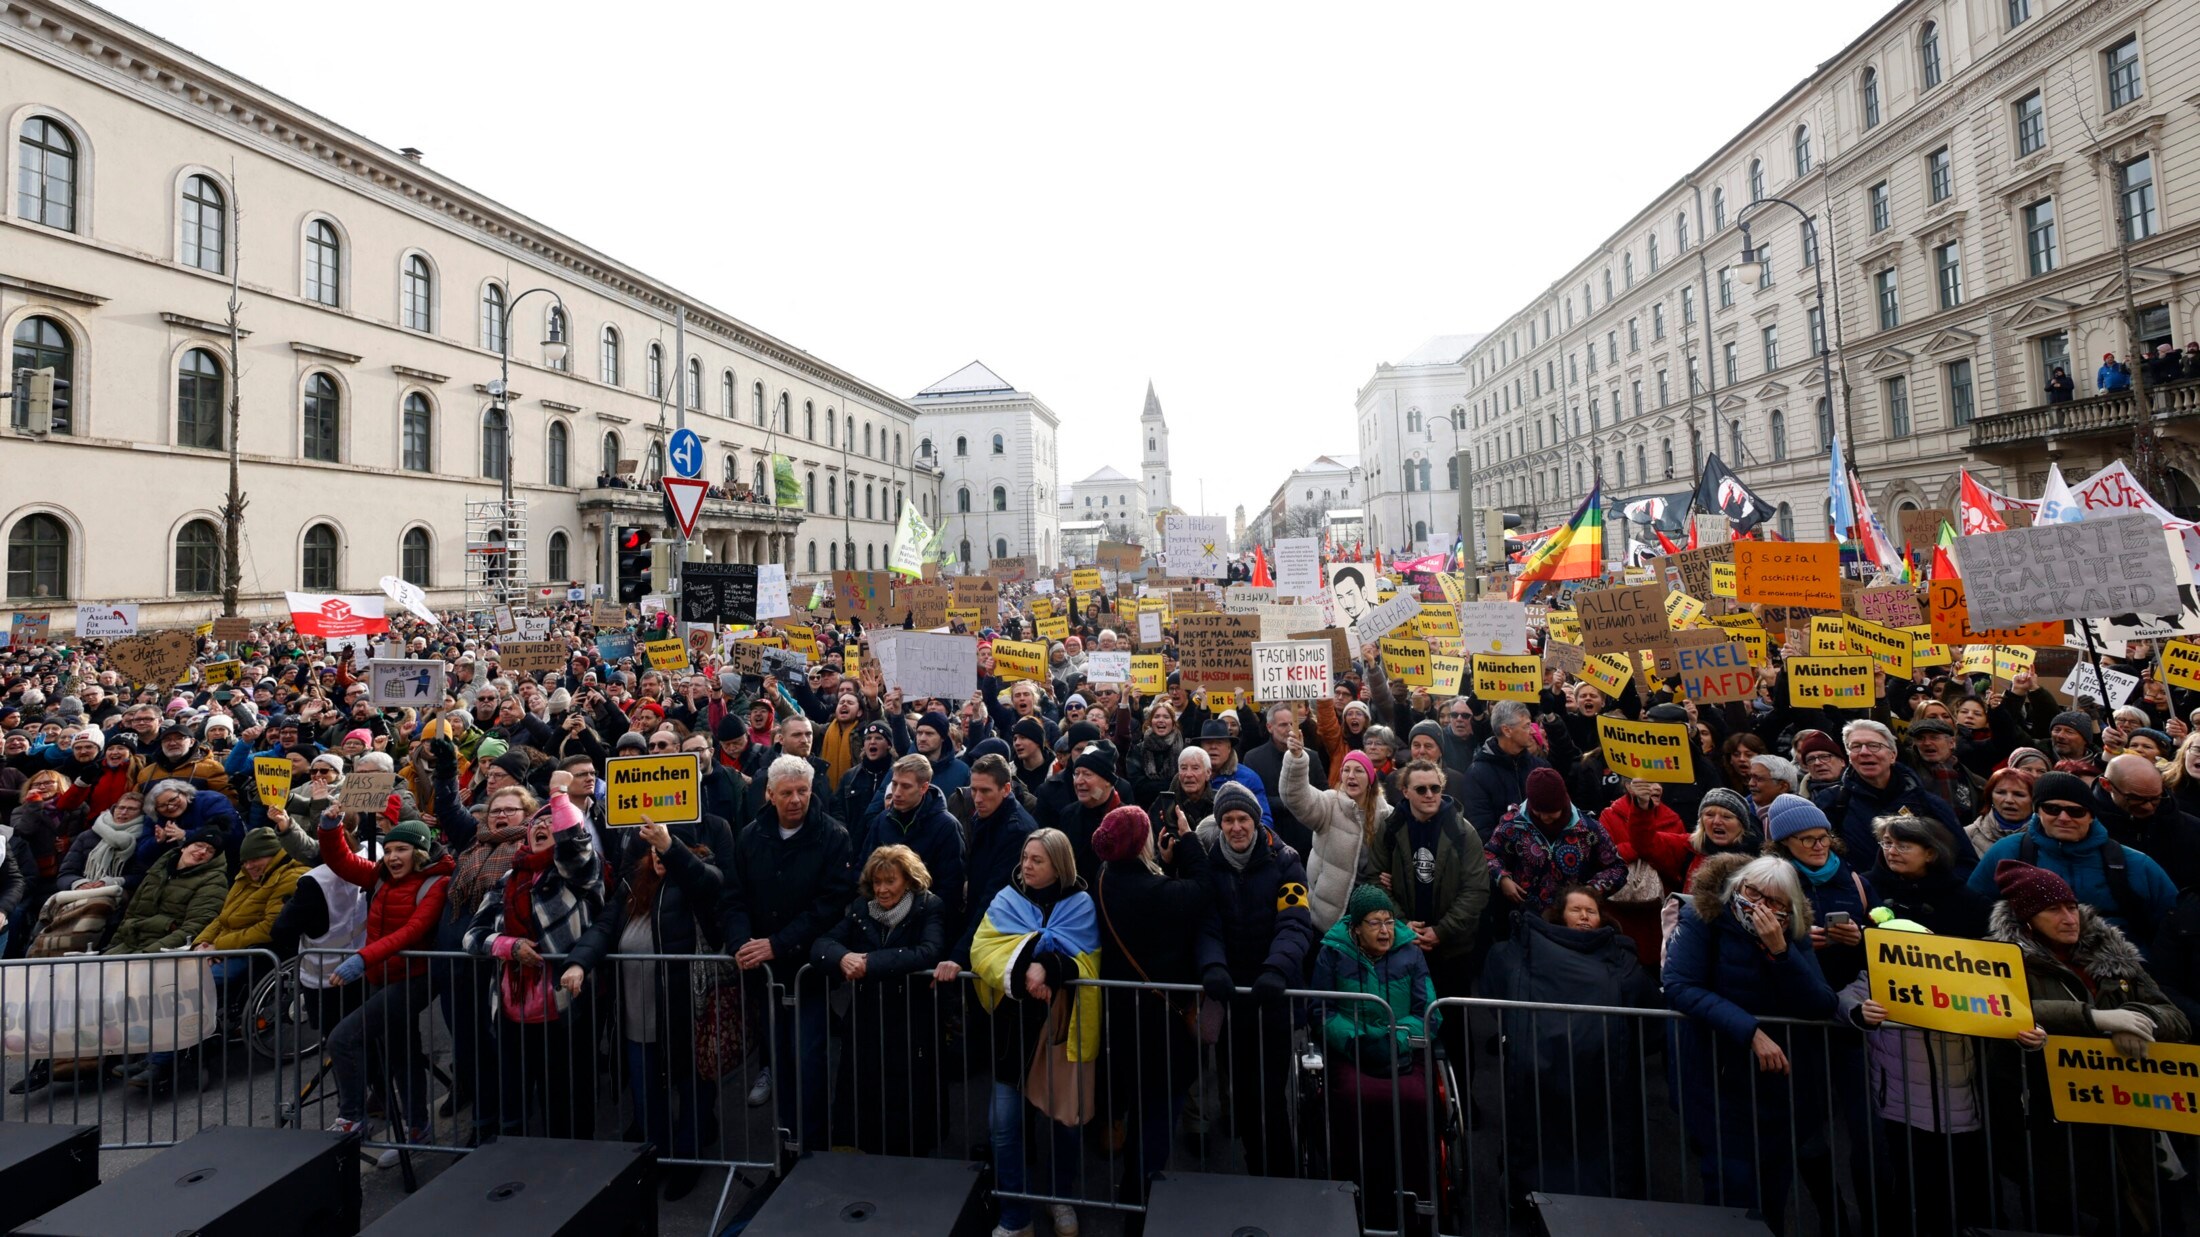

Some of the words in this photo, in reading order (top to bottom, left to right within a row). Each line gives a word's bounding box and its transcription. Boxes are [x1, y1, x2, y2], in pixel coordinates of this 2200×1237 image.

[1167, 517, 1183, 532] Bei
[1188, 517, 1217, 532] Hitler
[1955, 515, 2150, 569] LIBERTE
[1680, 551, 1701, 564] DIE
[1761, 551, 1816, 564] sozial
[1968, 552, 2152, 601] EGALITE
[1717, 581, 1728, 590] ist
[1581, 590, 1650, 615] ALICE,
[1862, 591, 1895, 605] NAZIS
[1977, 589, 2076, 626] FUCK
[2080, 583, 2156, 613] AFD
[1421, 608, 1453, 618] München
[1524, 606, 1546, 617] AZIS
[1667, 595, 1684, 617] chen
[1865, 605, 1881, 615] EN
[1886, 603, 1914, 614] HEIM-
[1674, 601, 1695, 626] bunt!
[86, 621, 99, 629] FÜR
[525, 619, 544, 629] Bier
[1183, 617, 1202, 627] DAS
[1205, 616, 1222, 627] IST
[1225, 617, 1241, 627] JA
[1422, 621, 1431, 630] ist
[1432, 621, 1454, 631] bunt!
[1525, 618, 1547, 628] AUS
[1584, 614, 1635, 632] NIEMAND
[85, 628, 135, 636] DEUTSCHLAND
[1183, 630, 1209, 640] NICHT
[1210, 630, 1229, 639] MAL
[1846, 620, 1905, 651] München
[2134, 627, 2173, 638] Hüseyin
[503, 645, 521, 655] NIE
[525, 643, 562, 654] WIEDER
[648, 643, 682, 655] München
[1198, 639, 1212, 648] ICH
[1215, 639, 1234, 648] SAG
[1383, 643, 1425, 658] München
[1592, 638, 1613, 649] dein
[1818, 639, 1836, 651] ist
[133, 648, 170, 662] Herz
[735, 643, 747, 655] Es
[748, 645, 761, 659] ist
[995, 644, 1040, 661] München
[1181, 649, 1196, 658] DAS
[1200, 649, 1212, 658] IST
[1258, 648, 1325, 663] FASCHISMUS
[1679, 644, 1748, 671] EKEL
[1850, 637, 1864, 654] ist
[1865, 645, 1903, 668] bunt!
[1913, 644, 1942, 658] unt!
[508, 657, 527, 668] IST
[531, 655, 563, 666] JETZT
[734, 656, 741, 670] 5
[753, 661, 762, 676] 12
[1012, 662, 1039, 675] bunt!
[1181, 658, 1197, 668] NUR
[1201, 658, 1249, 668] NORMAL
[1432, 660, 1459, 672] chen
[1477, 660, 1536, 674] München
[1965, 656, 1980, 667] ist
[2080, 661, 2095, 675] Aus
[144, 665, 177, 681] Hetze
[1182, 670, 1200, 682] ALLE
[1201, 670, 1230, 681] HASSEN
[1262, 667, 1283, 682] IST
[1286, 665, 1327, 681] KEINE
[1394, 662, 1424, 676] bunt!
[1587, 663, 1620, 687] bunt!
[1794, 663, 1868, 677] München
[2167, 663, 2190, 678] ist
[1262, 684, 1318, 700] MEINUNG
[1480, 678, 1496, 691] ist
[1498, 680, 1535, 693] bunt!
[1685, 671, 1756, 700] HAFD
[1799, 683, 1820, 697] ist
[1823, 683, 1866, 698] bunt!
[1602, 725, 1680, 747] München
[1609, 748, 1628, 766] ist
[1630, 753, 1680, 772] bunt!
[257, 764, 291, 778] München
[614, 766, 691, 785] München
[346, 775, 374, 789] HASS
[260, 783, 270, 796] ist
[617, 793, 639, 810] ist
[641, 789, 689, 808] bunt!
[1878, 942, 2012, 979] München
[1888, 979, 1924, 1006] ist
[1931, 984, 2013, 1018] bunt!
[2057, 1048, 2200, 1078] München
[2067, 1081, 2105, 1105] ist
[2111, 1084, 2199, 1114] bunt!
